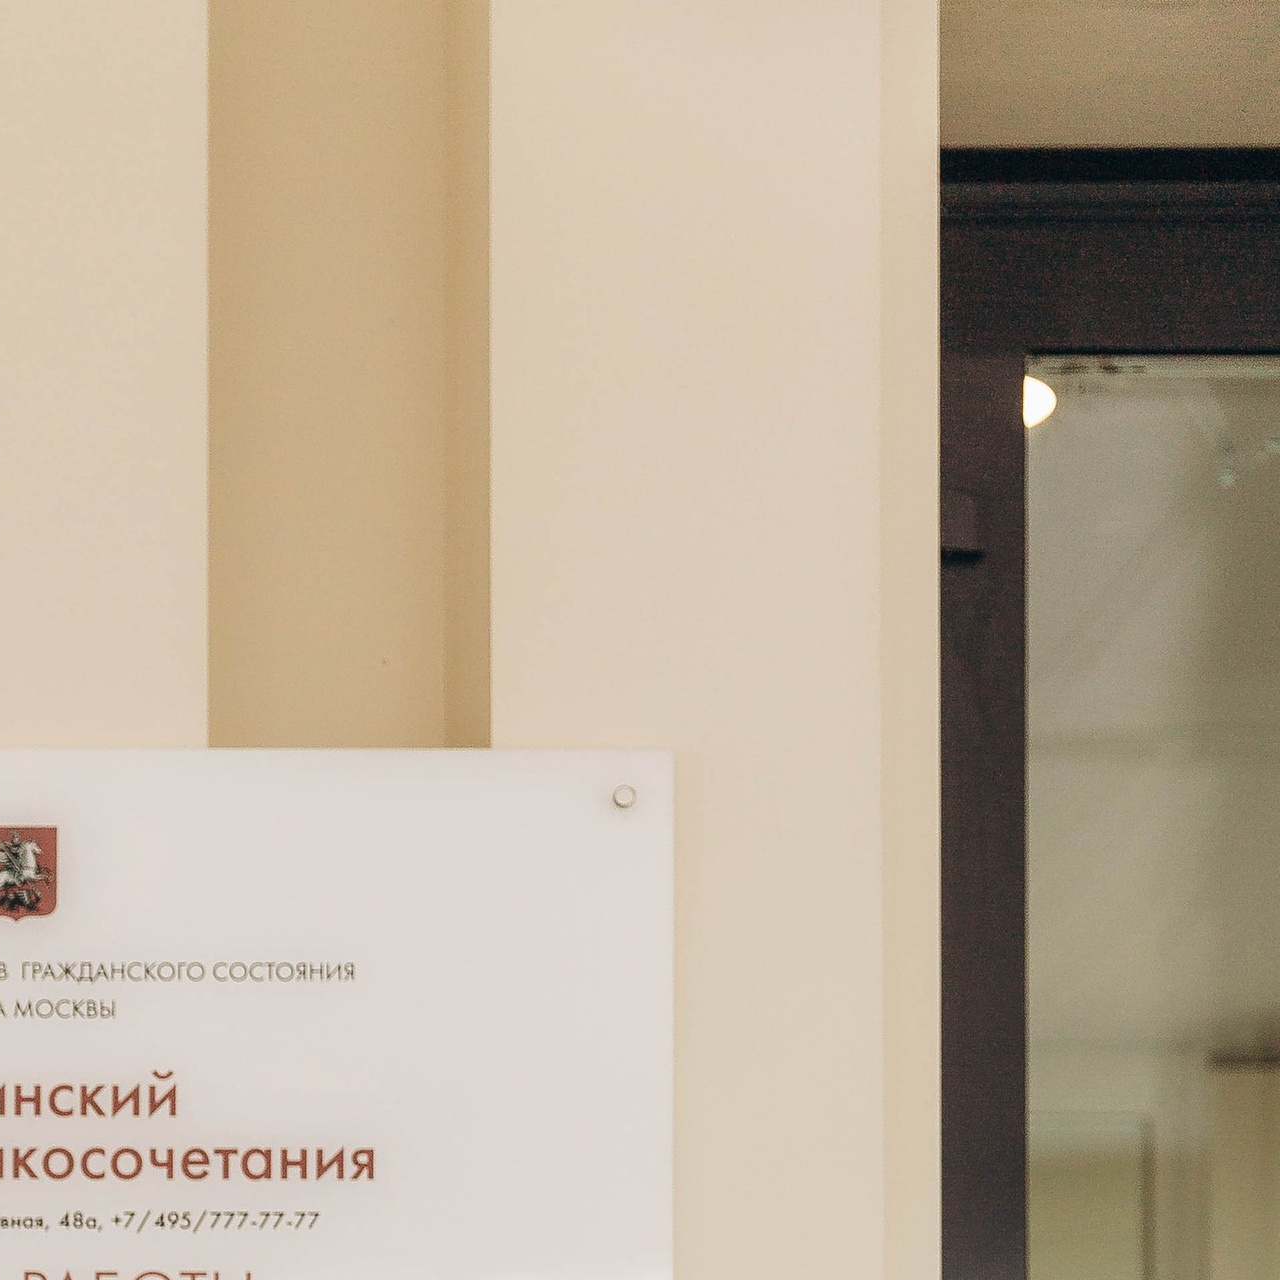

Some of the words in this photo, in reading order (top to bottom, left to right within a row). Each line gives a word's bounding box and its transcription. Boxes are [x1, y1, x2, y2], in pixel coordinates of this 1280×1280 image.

[21, 961, 206, 984] ГРАЖДАНСКОГО
[212, 961, 356, 983] СОСТОЯНИЯ
[13, 998, 116, 1019] МОСКВЫ
[59, 1211, 103, 1231] 48а,
[112, 1210, 320, 1233] +7/495/777-77-77
